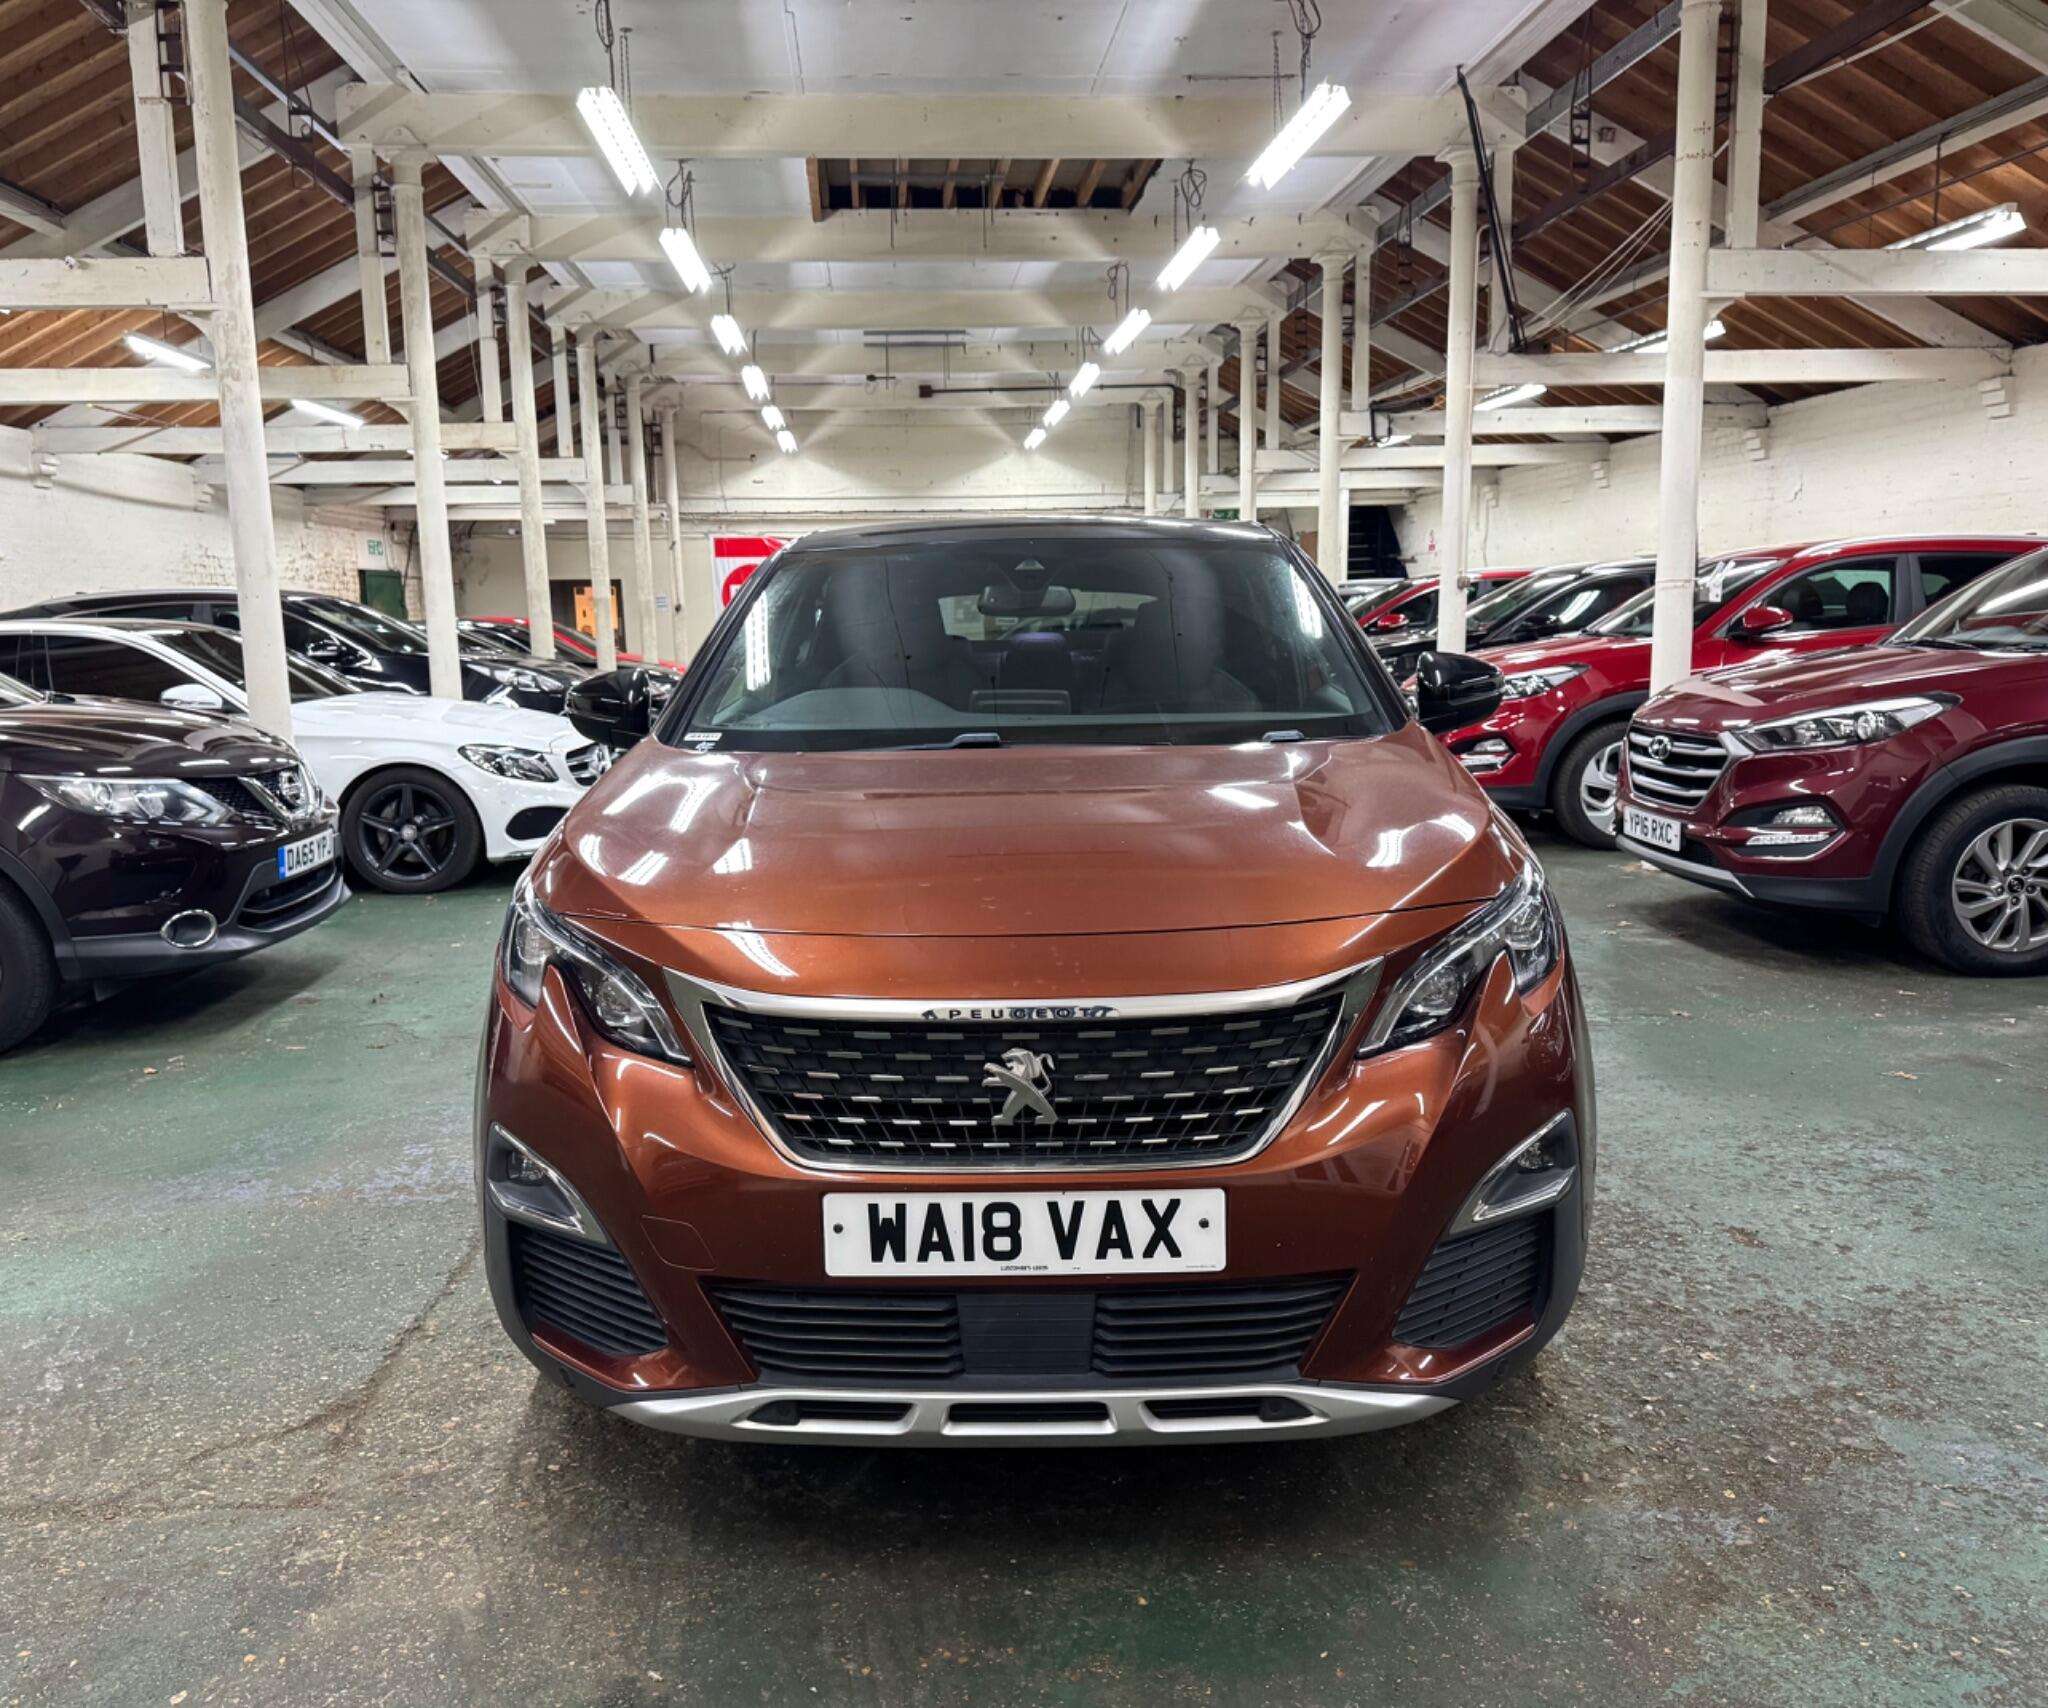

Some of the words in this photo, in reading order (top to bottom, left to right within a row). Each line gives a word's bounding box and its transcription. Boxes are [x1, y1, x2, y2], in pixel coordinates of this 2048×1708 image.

[1651, 819, 1672, 844] RXC
[286, 841, 315, 871] DA65
[949, 1007, 1093, 1020] PEUGEOT
[867, 1201, 1023, 1263] WA18
[1046, 1198, 1182, 1261] VAX
